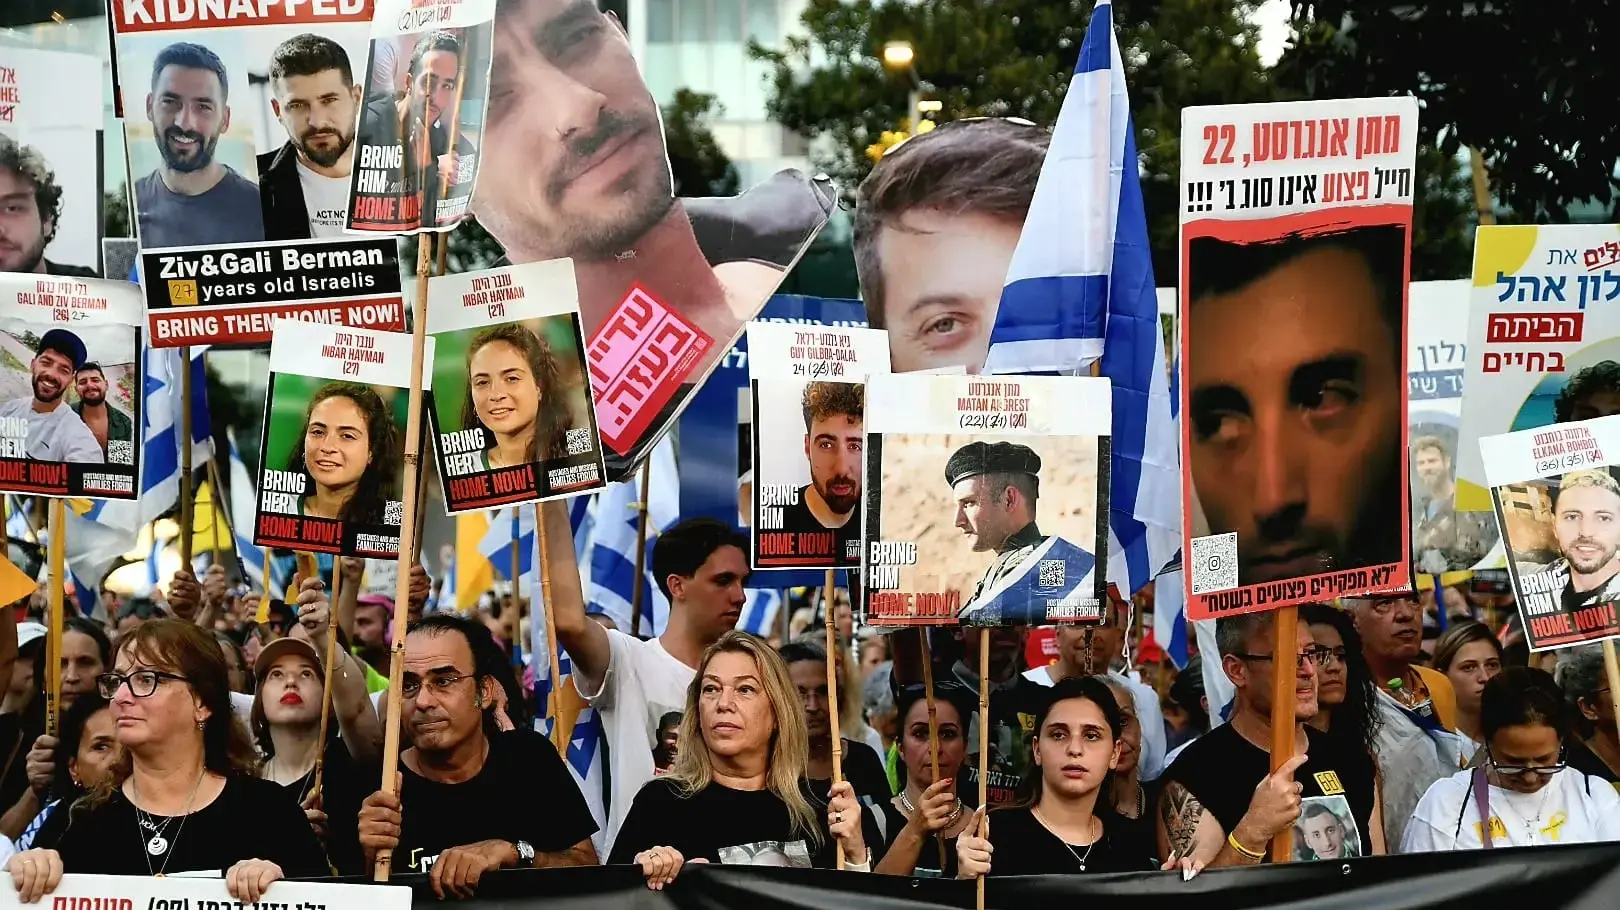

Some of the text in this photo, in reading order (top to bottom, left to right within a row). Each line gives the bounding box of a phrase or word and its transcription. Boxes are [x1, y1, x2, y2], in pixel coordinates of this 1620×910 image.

[124, 0, 365, 25] KIDNAPPED
[0, 87, 20, 103] HEL
[1203, 115, 1400, 168] מתן אנגרסט, 22
[360, 145, 404, 169] BRING
[357, 170, 387, 193] HIM
[1240, 177, 1273, 209] סוג
[1279, 174, 1317, 206] אינו
[1322, 170, 1369, 203] פצוע
[1374, 166, 1411, 199] חייל
[354, 196, 396, 219] HOME
[1187, 181, 1213, 212] !!!
[333, 210, 346, 219] NO
[159, 248, 383, 279] Ziv&Gali Berman
[1547, 248, 1578, 266] את
[172, 283, 194, 300] 27
[201, 271, 375, 302] years old Israelis
[491, 273, 512, 289] ענבר
[1496, 269, 1620, 310] לון אהל
[17, 292, 107, 311] GALI AND ZIV BERMAN
[462, 286, 525, 308] INBAR HAYMAN
[156, 315, 219, 340] BRING
[223, 312, 281, 334] THEM
[347, 303, 400, 326] NOW!
[487, 303, 505, 319] (27)
[1492, 315, 1575, 339] הביתה
[355, 334, 375, 349] ענבר
[321, 344, 385, 364] INBAR HAYMAN
[790, 346, 857, 363] GUY GILBOA-DALAL
[1482, 352, 1566, 374] בחיים
[342, 360, 360, 376] (27)
[606, 321, 692, 427] בעזה!
[957, 397, 989, 411] MATAN
[0, 417, 29, 437] RING
[0, 437, 26, 458] HEM
[440, 427, 486, 455] BRING
[1532, 438, 1600, 460] ELKANA BOHBOT
[0, 461, 69, 485] OME NOW!
[445, 453, 475, 476] HER
[263, 468, 307, 494] BRING
[450, 464, 536, 500] HOME NOW!
[261, 494, 290, 514] HER
[760, 483, 799, 507] BRING
[259, 515, 344, 545] HOME NOW!
[760, 507, 784, 530] HIM
[385, 543, 400, 553] FOR
[760, 530, 836, 555] HOME NOW!
[846, 546, 861, 558] FAMI
[870, 541, 917, 566] BRING
[869, 565, 900, 590] HIM
[1311, 572, 1368, 596] מפקירים
[1519, 569, 1563, 595] BRING
[868, 589, 961, 617] HOME NOW!
[1256, 580, 1307, 605] פצועים
[1523, 592, 1556, 616] HIM
[1530, 601, 1618, 638] HOME NOW!
